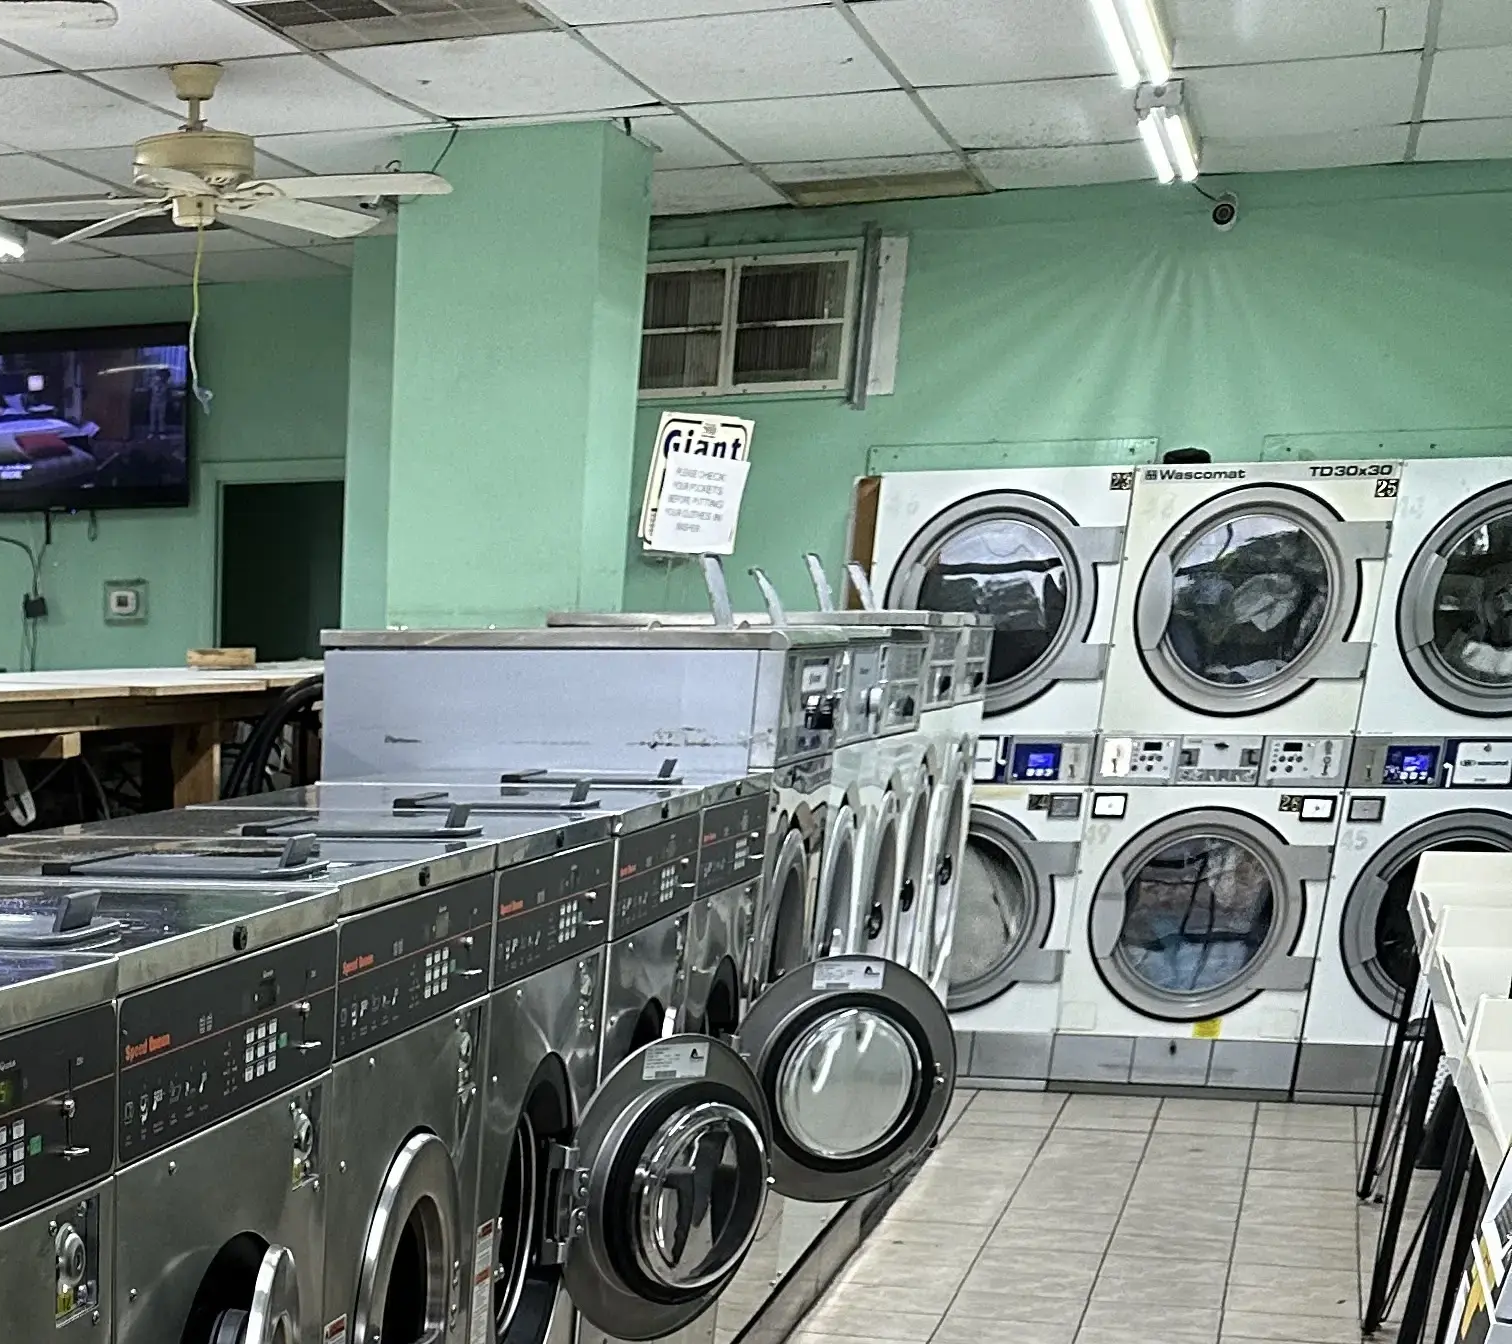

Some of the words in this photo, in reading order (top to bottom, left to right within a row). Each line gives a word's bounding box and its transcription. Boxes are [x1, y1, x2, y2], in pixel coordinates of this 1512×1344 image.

[664, 429, 742, 461] Giant
[1159, 468, 1246, 480] Wascomat
[1309, 464, 1393, 478] TD30x30
[1376, 480, 1399, 497] 25
[125, 1039, 148, 1062] Speed
[149, 1033, 171, 1052] Queen
